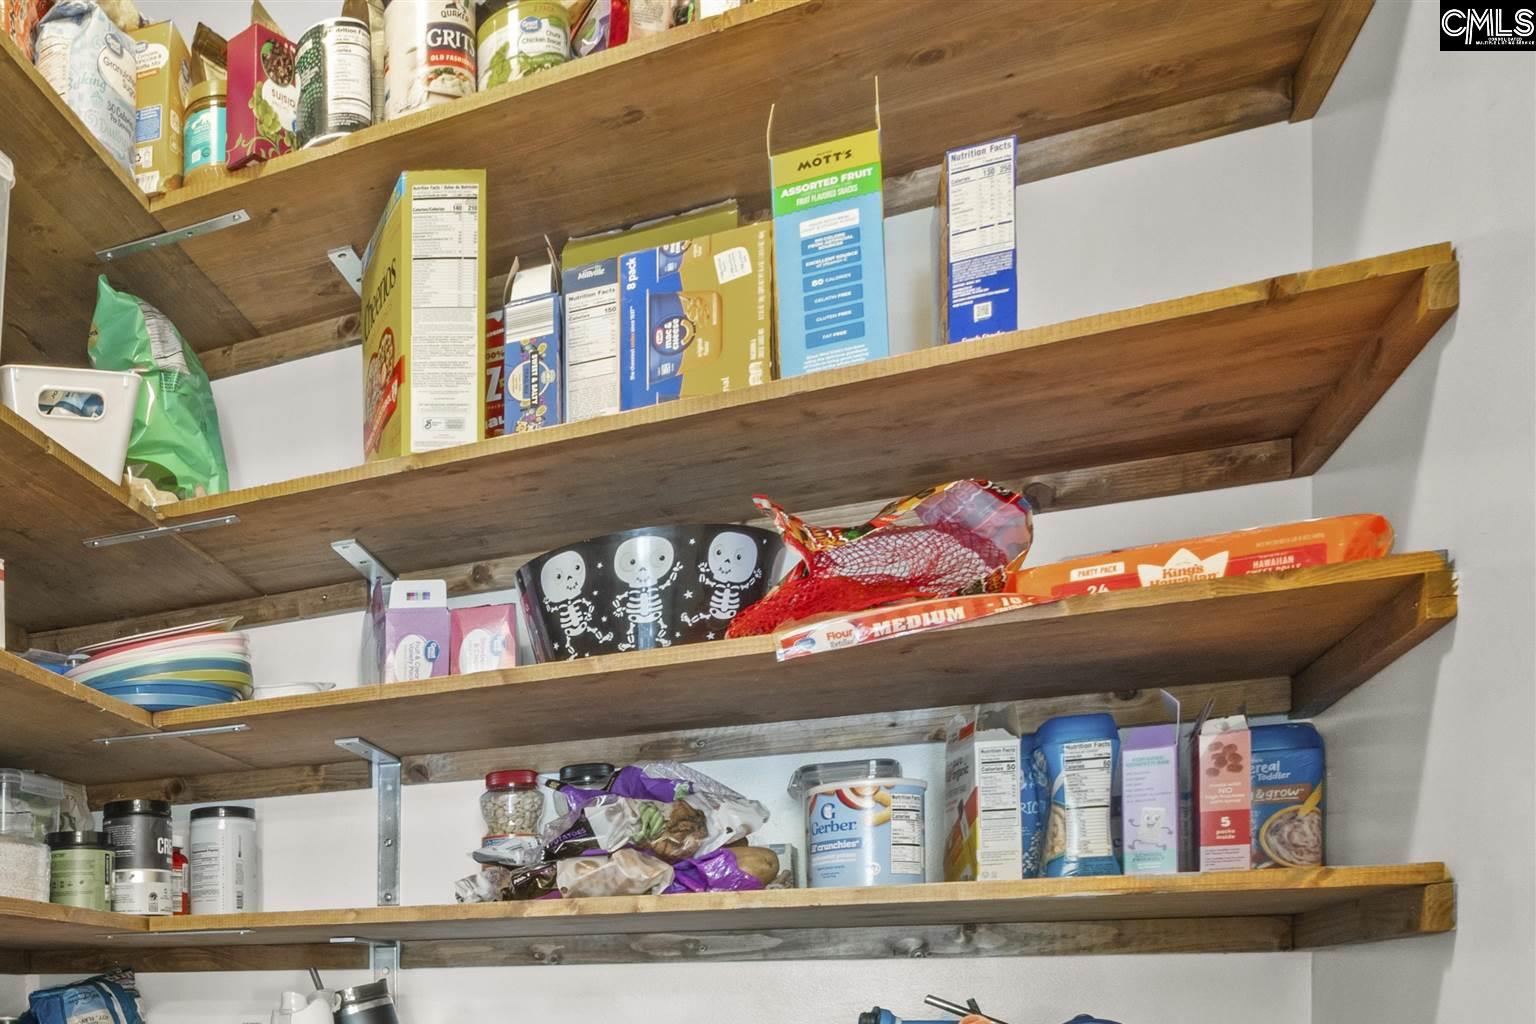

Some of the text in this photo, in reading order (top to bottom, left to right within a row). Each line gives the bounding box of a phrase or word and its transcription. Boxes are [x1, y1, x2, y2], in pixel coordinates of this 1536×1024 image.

[440, 9, 470, 22] QUAKER
[426, 28, 476, 54] GRITS
[430, 54, 445, 63] OLD
[951, 141, 1013, 162] Nutrition Facts
[797, 149, 853, 172] MOTT'S
[781, 167, 873, 198] ASSORTED FRUIT
[626, 257, 638, 290] 8 pack
[1252, 555, 1295, 570] HAWAIIAN
[1077, 564, 1117, 578] PARTY PACK
[1162, 564, 1205, 579] King's
[873, 606, 966, 638] MEDIUM
[826, 628, 854, 641] Flour
[1250, 760, 1280, 774] ereal
[1257, 770, 1291, 782] Toddler
[1256, 787, 1300, 802] & grow
[811, 820, 857, 836] Gerber
[1220, 816, 1231, 828] 5
